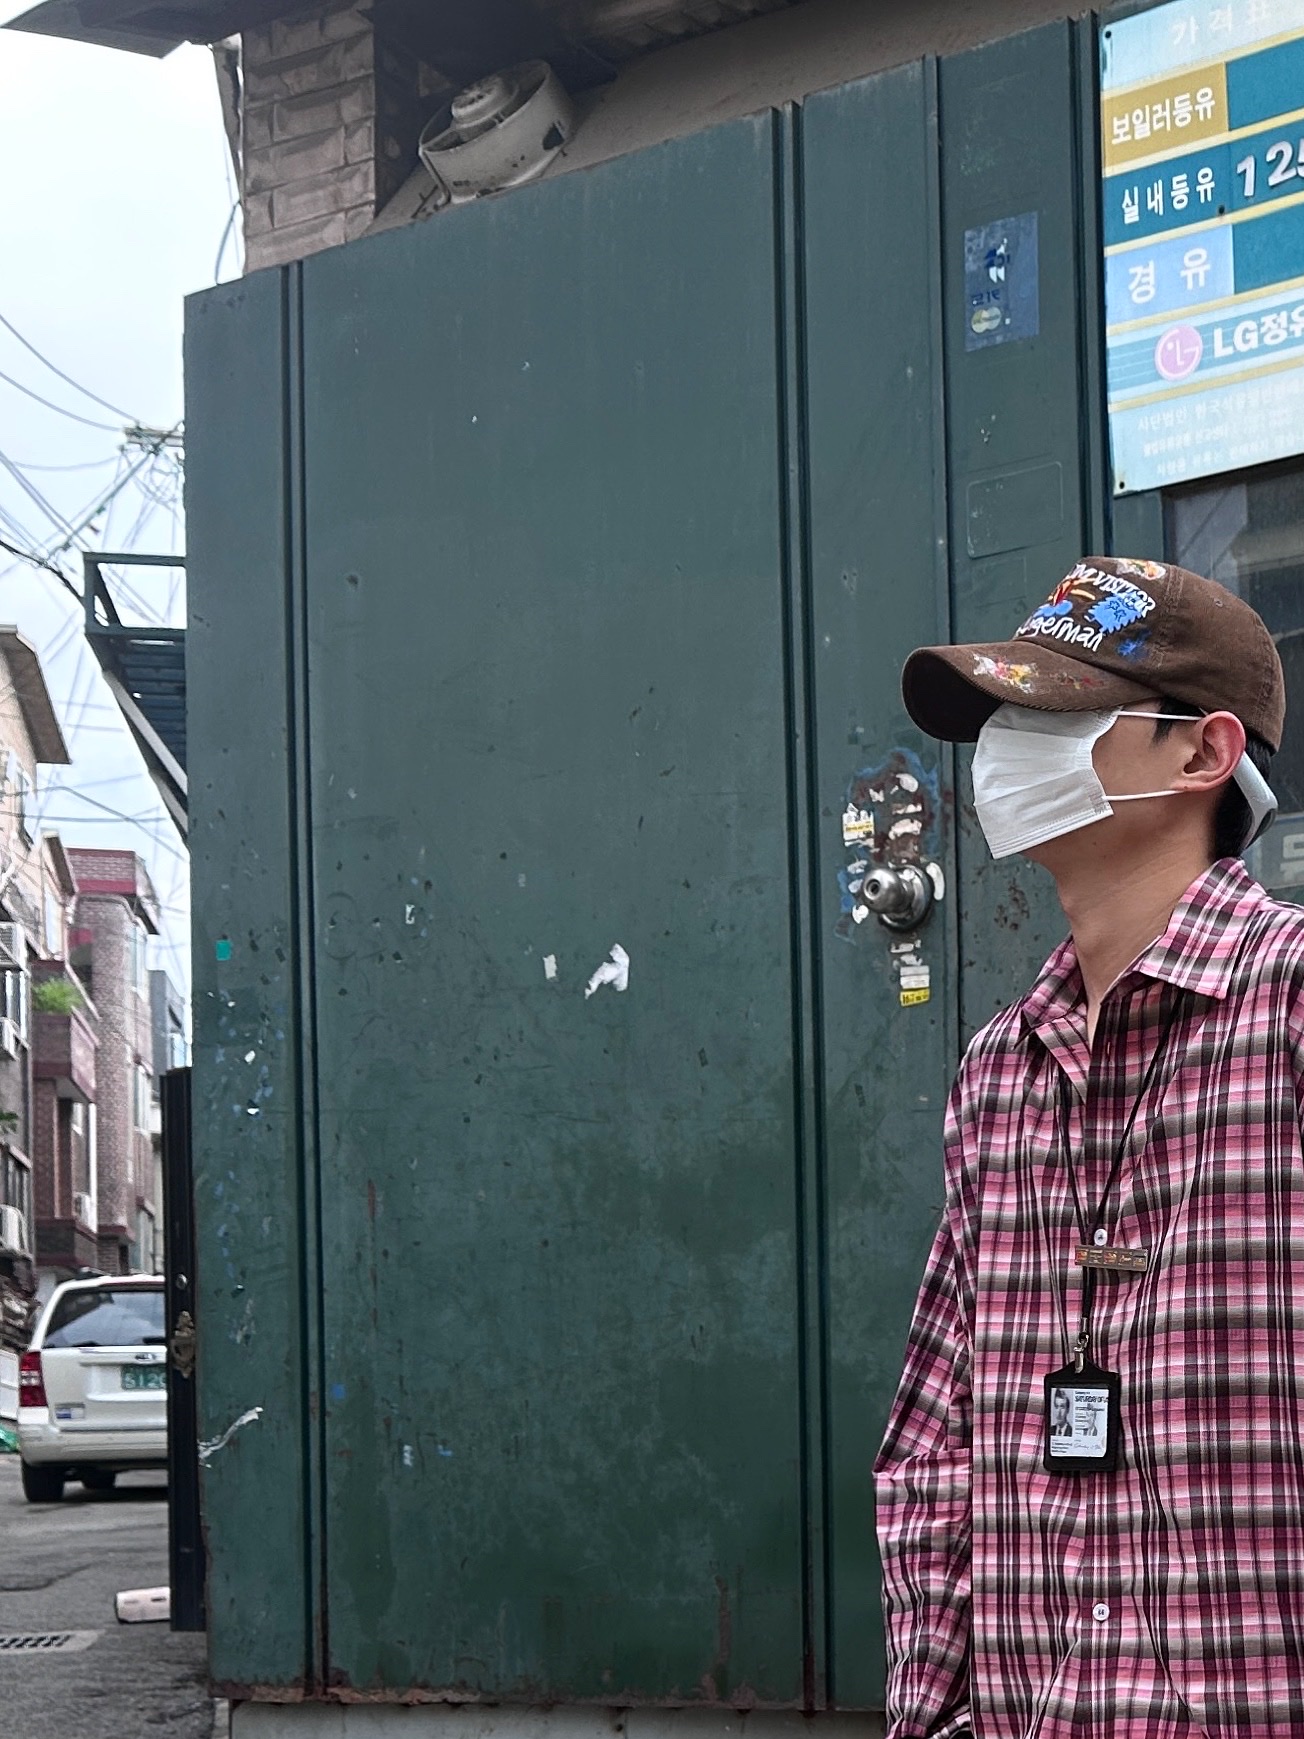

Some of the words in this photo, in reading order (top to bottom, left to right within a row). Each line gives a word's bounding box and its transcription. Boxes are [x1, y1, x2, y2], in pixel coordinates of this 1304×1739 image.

[1112, 86, 1216, 145] 보일러등유
[1121, 167, 1215, 225] 실내등유
[1127, 248, 1211, 304] 경유
